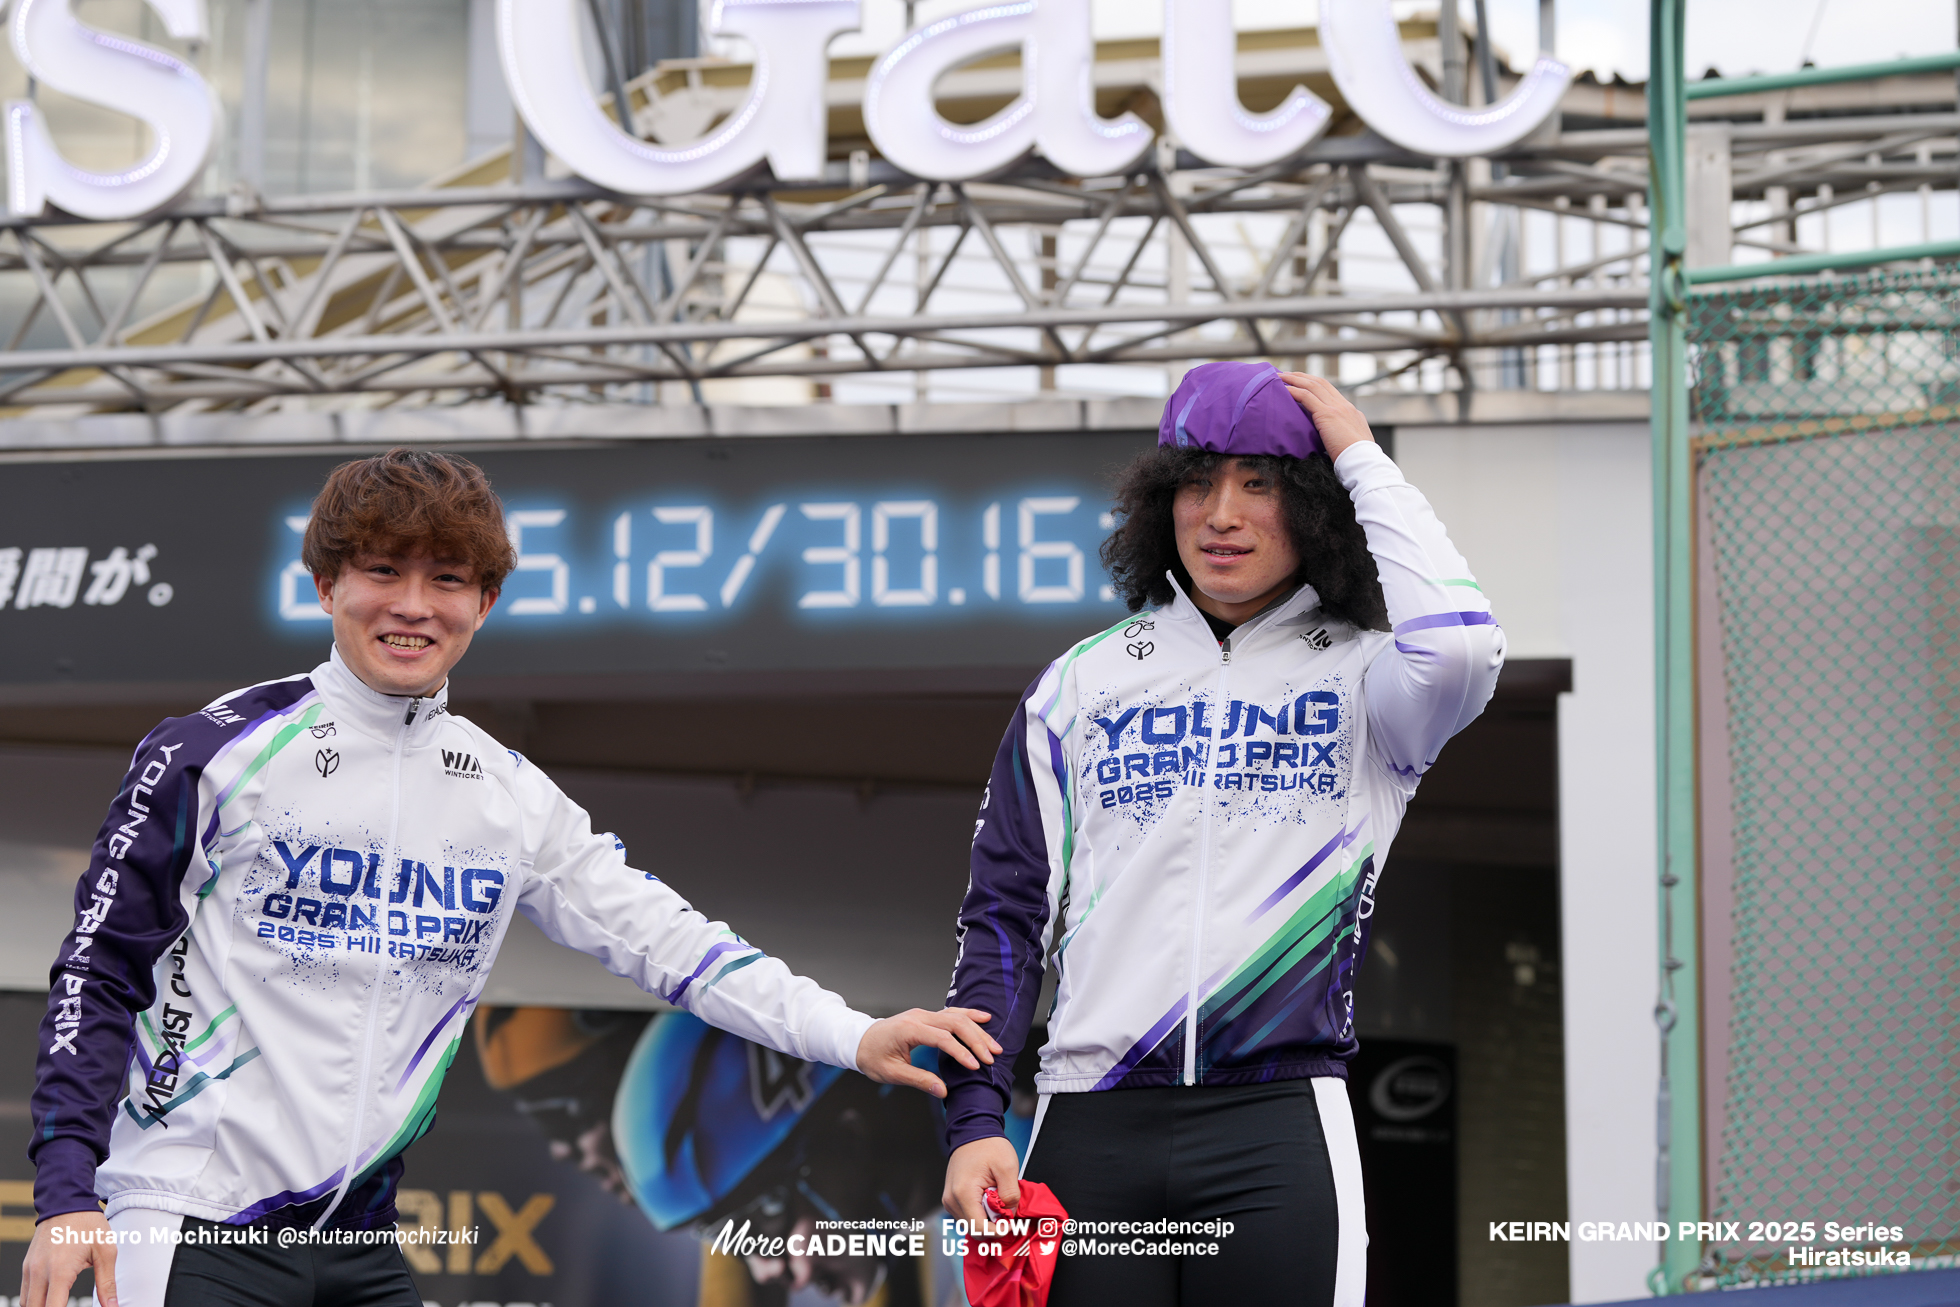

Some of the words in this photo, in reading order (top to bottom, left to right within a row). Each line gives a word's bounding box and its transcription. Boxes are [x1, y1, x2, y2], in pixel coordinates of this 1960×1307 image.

[1093, 690, 1340, 751] YOUNG
[1096, 741, 1238, 786] GRAND
[1245, 741, 1338, 769] PRIX
[109, 742, 184, 861] YOUNG
[1100, 780, 1174, 809] 2025
[272, 840, 506, 914] YOUNG
[256, 920, 336, 950] 2025
[346, 935, 480, 965] HIRATSUKA
[260, 892, 411, 937] GRAND
[415, 914, 491, 945] PRIX
[49, 973, 88, 1056] PRIX
[396, 1190, 556, 1277] RIX
